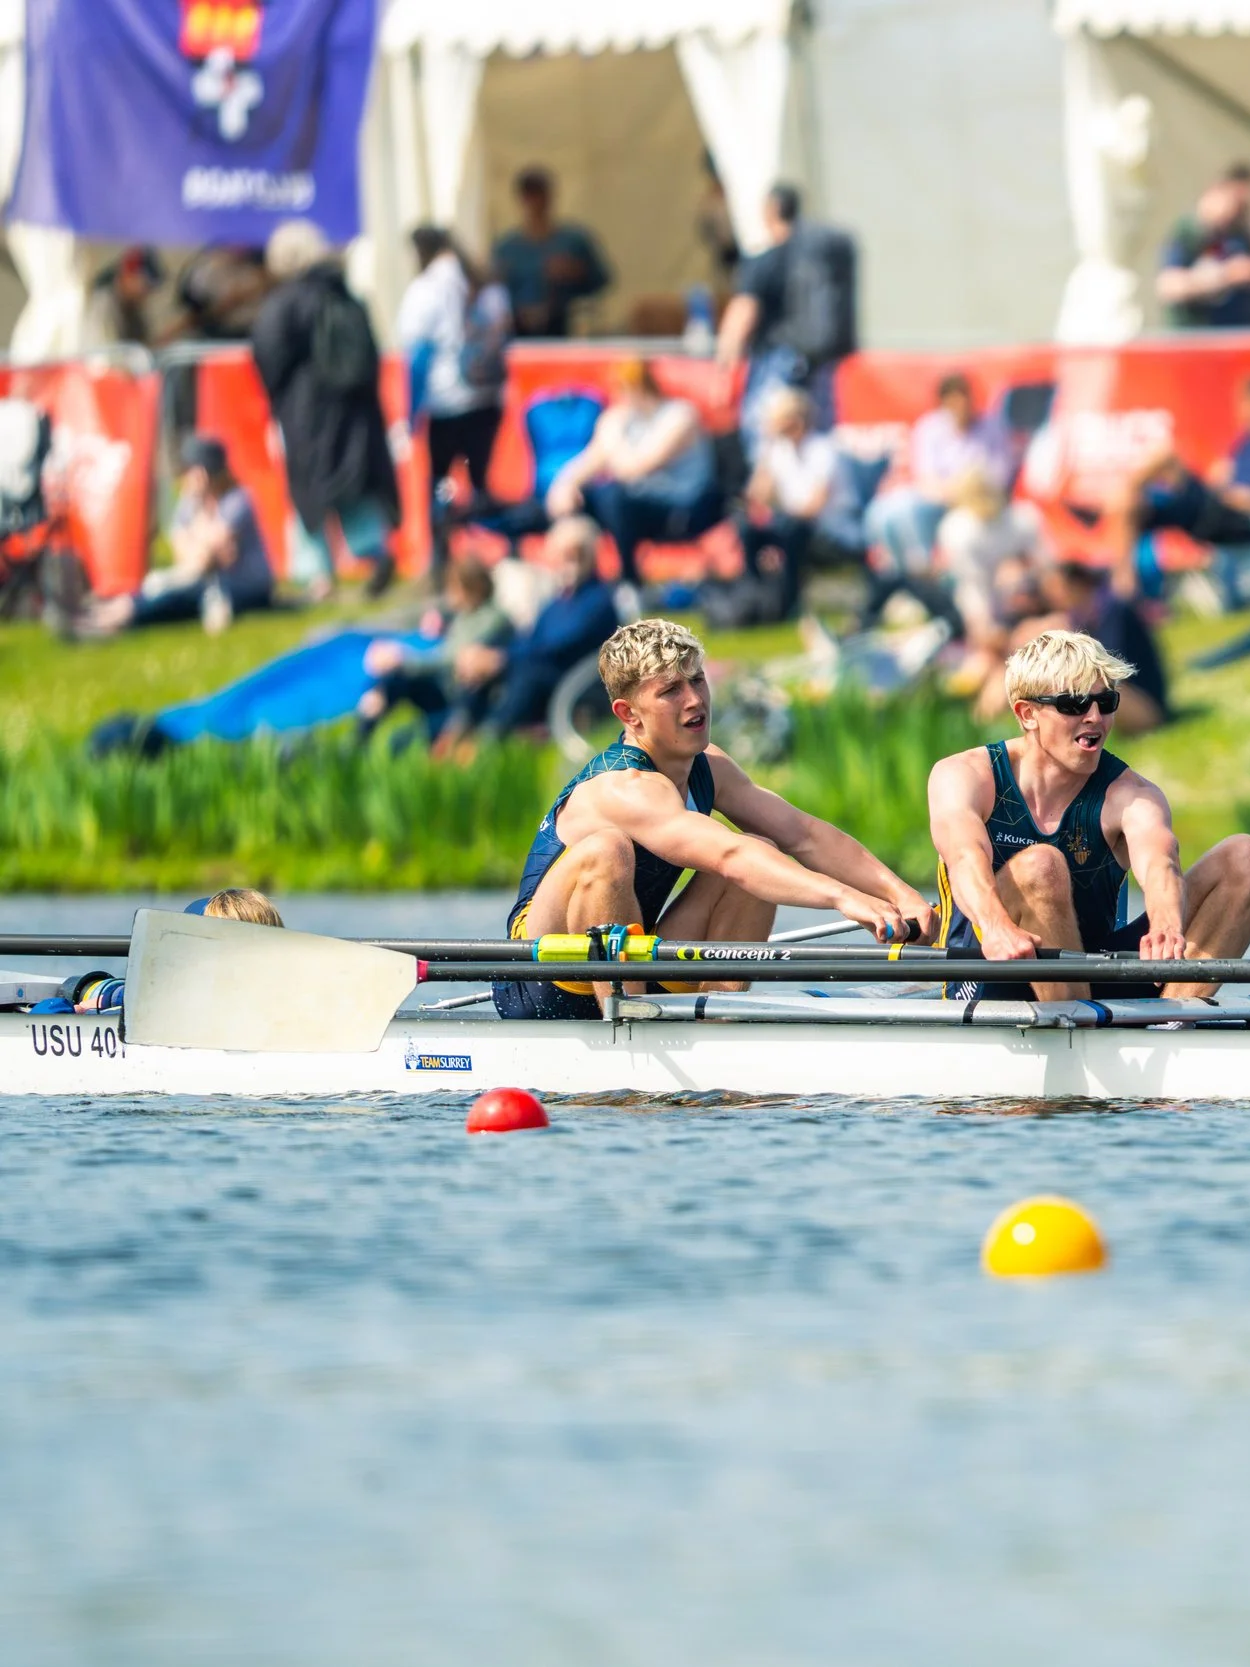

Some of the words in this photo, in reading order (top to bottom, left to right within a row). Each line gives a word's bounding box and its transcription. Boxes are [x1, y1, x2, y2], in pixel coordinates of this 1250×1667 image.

[704, 948, 776, 961] concept
[780, 949, 792, 960] 2
[31, 1024, 82, 1057] USU
